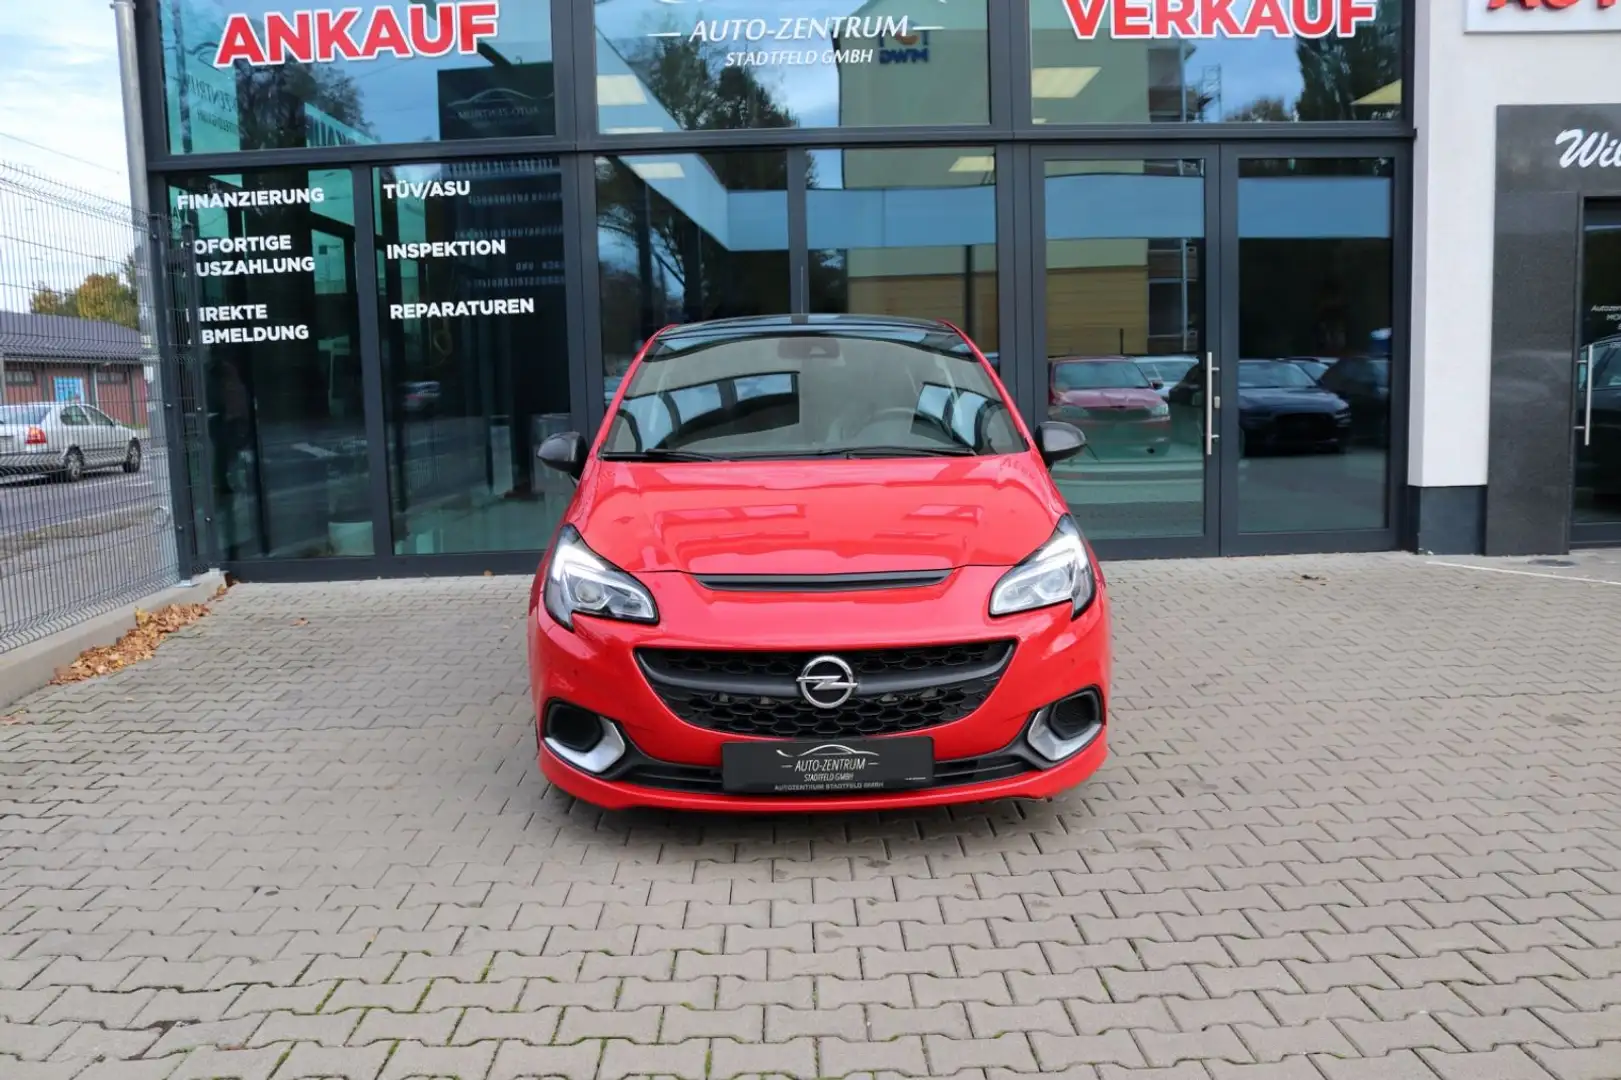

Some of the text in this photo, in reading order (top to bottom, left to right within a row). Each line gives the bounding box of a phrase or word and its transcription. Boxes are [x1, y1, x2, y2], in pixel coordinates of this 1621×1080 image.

[689, 14, 909, 43] AUTO-ZENTRUM
[1062, 0, 1377, 39] VERKAUF
[214, 2, 499, 67] ANKAUF
[724, 48, 873, 67] STADTFELD GMBH
[177, 187, 325, 210] FINANZIERUNG
[383, 180, 471, 200] TÜV/ASU
[181, 235, 293, 255] OFORTIGE
[387, 239, 506, 260] INSPEKTION
[183, 256, 316, 278] USZAHLUNG
[186, 304, 268, 323] IREKTE
[390, 297, 535, 320] REPARATUREN
[187, 324, 310, 345] BMELDUNG
[794, 758, 866, 773] AUTO-ZENTRUM
